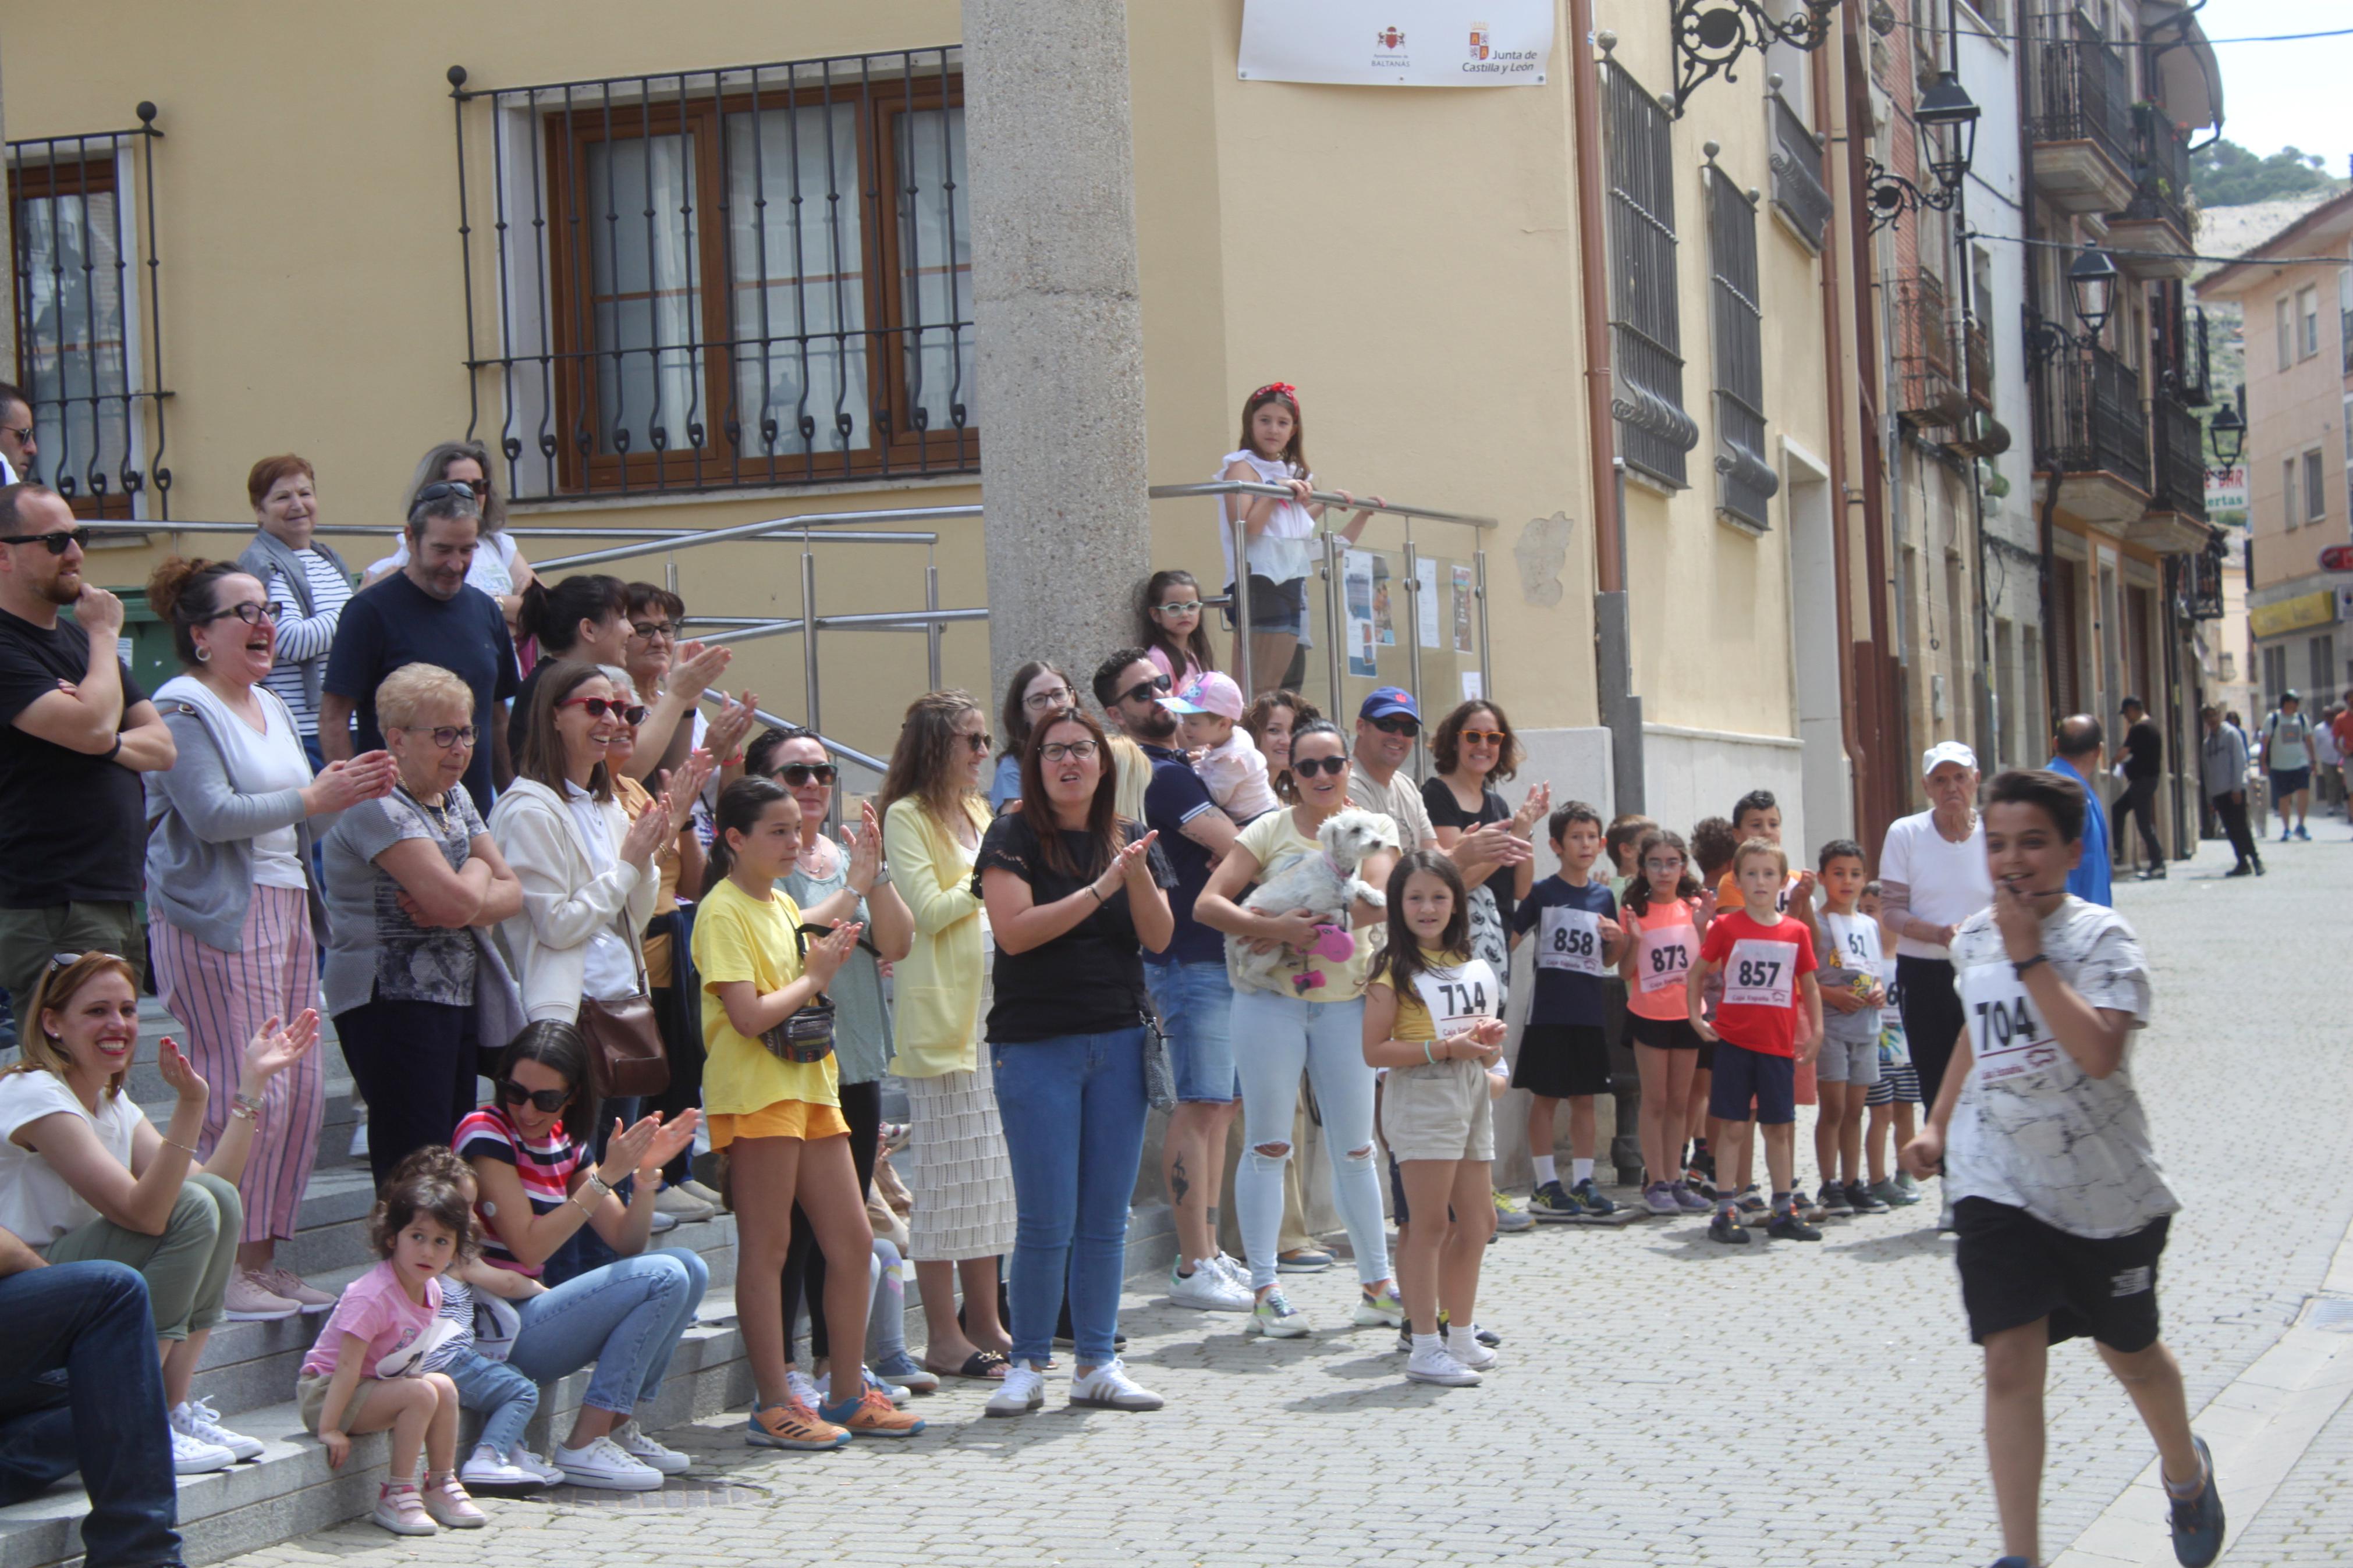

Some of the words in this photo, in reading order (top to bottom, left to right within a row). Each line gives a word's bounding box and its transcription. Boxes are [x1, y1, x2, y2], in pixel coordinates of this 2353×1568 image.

[1461, 62, 1500, 72] Castilla
[1500, 65, 1508, 74] y
[1510, 62, 1534, 72] León
[1492, 50, 1522, 59] Junta
[1525, 51, 1538, 59] de
[1554, 927, 1593, 956] 858
[1848, 933, 1867, 958] 61
[1651, 944, 1688, 972] 873
[1739, 960, 1781, 987] 857
[1438, 982, 1486, 1016] 714
[1974, 996, 2038, 1051] 704
